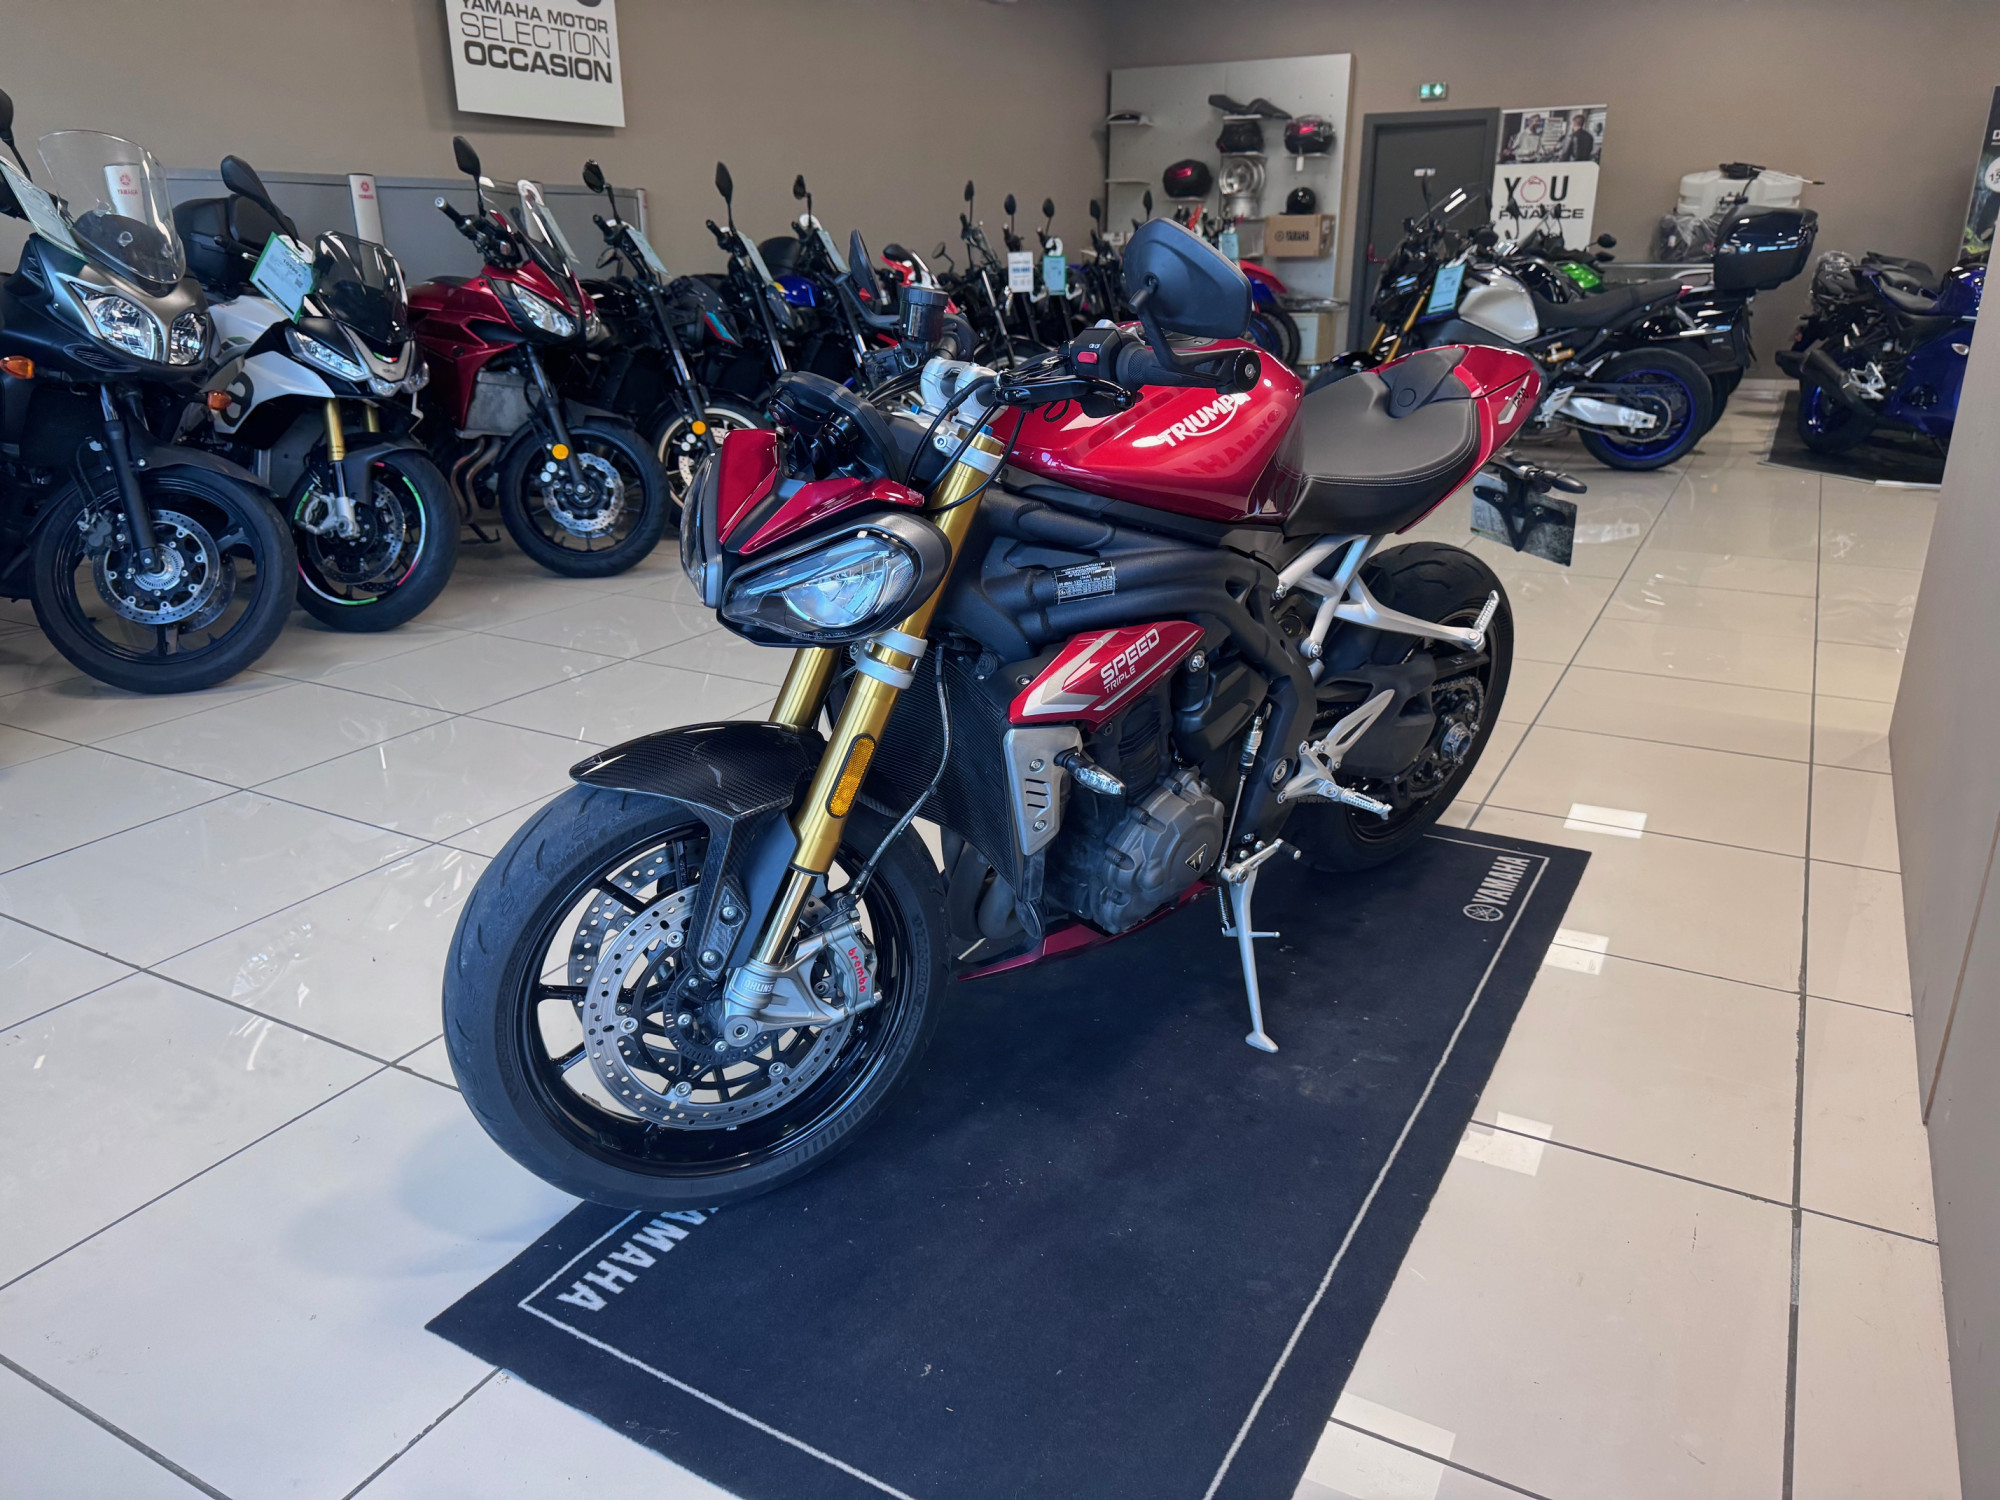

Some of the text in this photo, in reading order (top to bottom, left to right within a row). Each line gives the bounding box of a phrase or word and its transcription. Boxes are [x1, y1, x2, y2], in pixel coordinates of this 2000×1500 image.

[460, 12, 611, 59] SELECTION
[461, 0, 609, 34] YAMAHA MOTOR
[463, 40, 613, 84] OCCASION
[1499, 208, 1584, 220] FNANCE
[1100, 628, 1160, 686] SPEED
[1104, 664, 1136, 693] TRIPLE
[1471, 855, 1531, 906] YAMAHA
[848, 946, 868, 993] brembo
[556, 1207, 719, 1312] AMAHA
